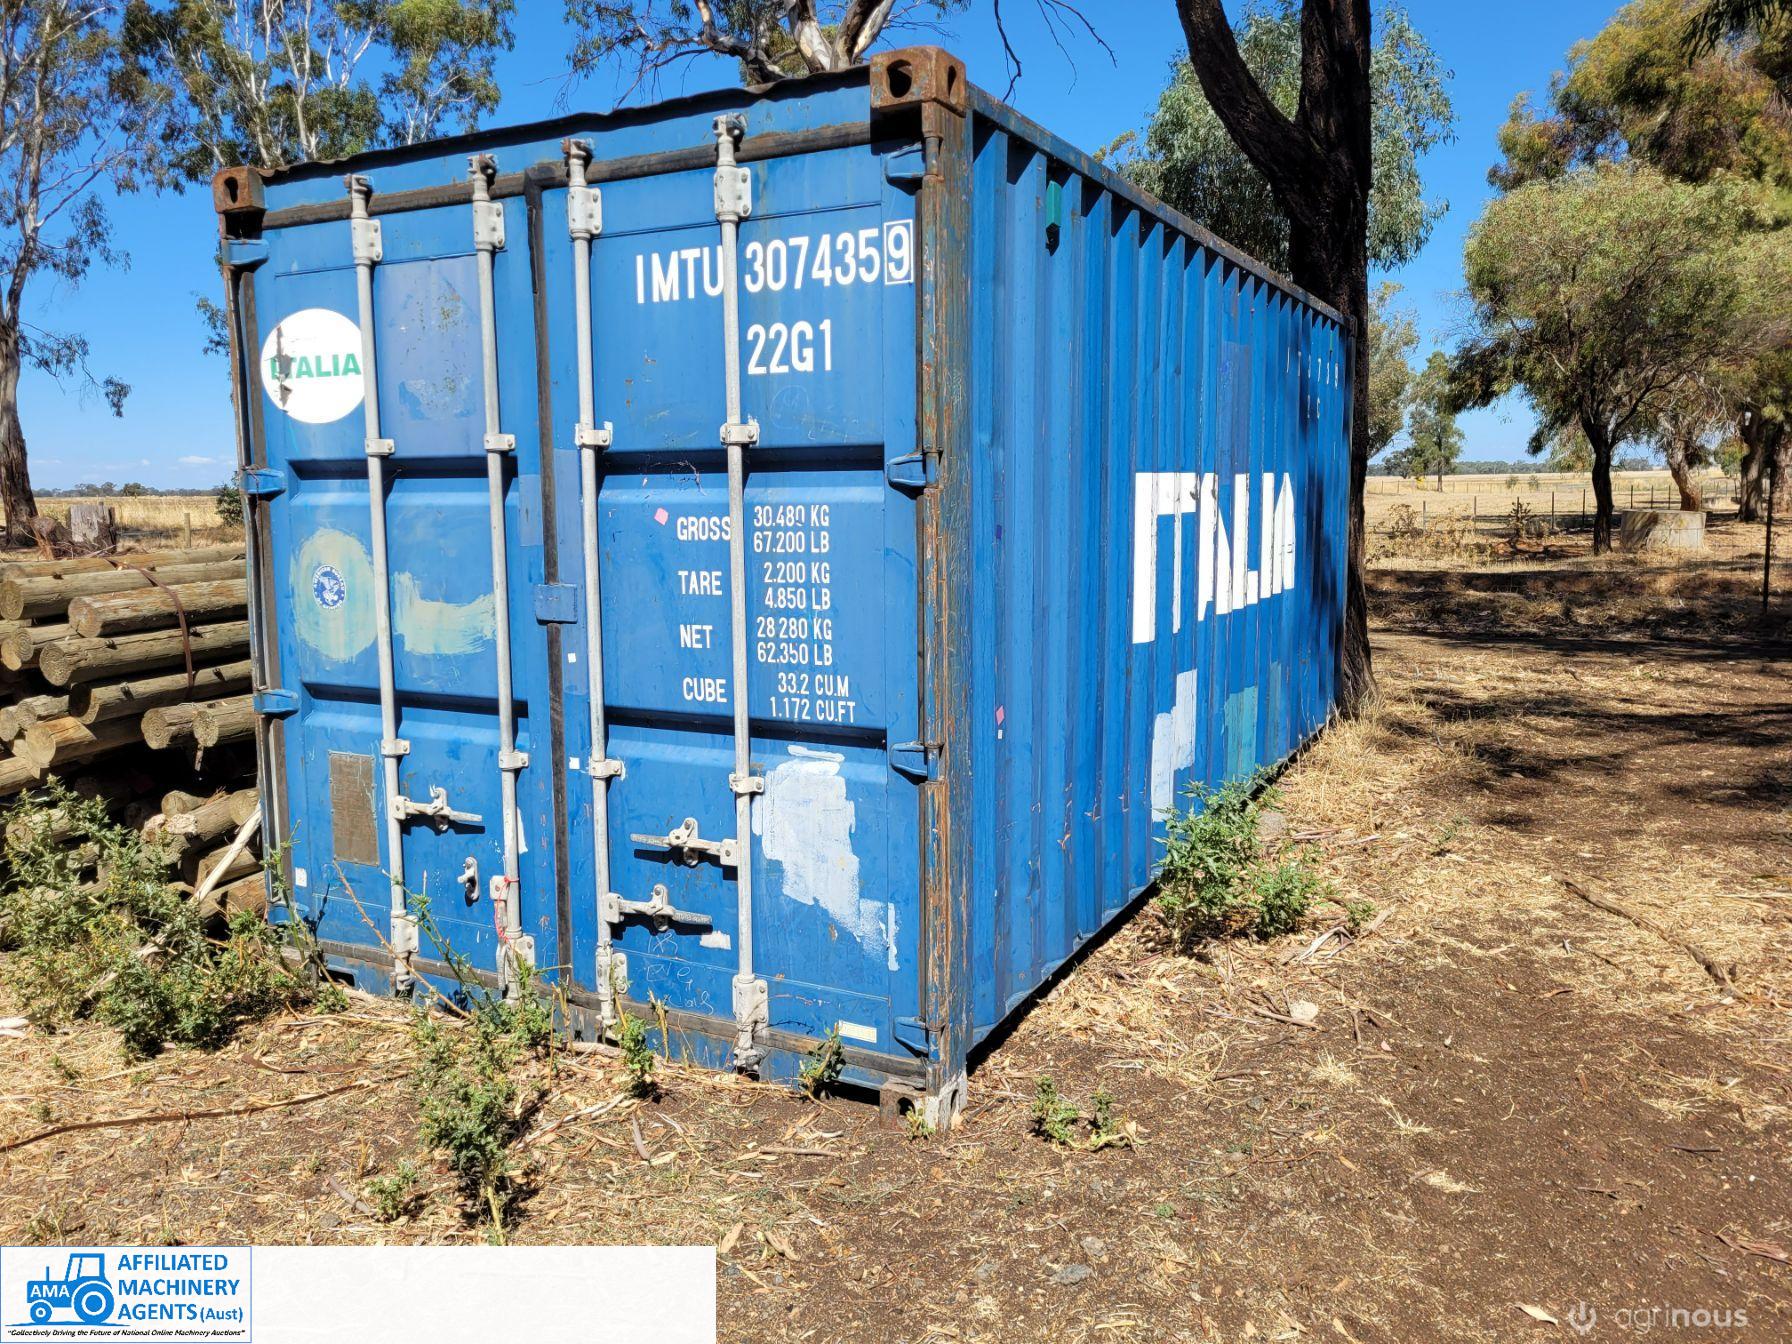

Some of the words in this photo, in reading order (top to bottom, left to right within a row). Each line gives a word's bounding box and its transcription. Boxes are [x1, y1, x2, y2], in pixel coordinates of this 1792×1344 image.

[636, 245, 724, 304] IMTU
[747, 319, 832, 375] 22G1
[753, 505, 805, 527] 30.480
[810, 505, 829, 527] KG
[677, 516, 731, 541] GROSS
[753, 531, 805, 553] 67.200
[810, 531, 829, 553] LB
[678, 571, 722, 595] TARE
[764, 562, 806, 583] 2.200
[811, 562, 830, 584] KG
[764, 587, 806, 609] 4.850
[812, 588, 831, 609] LB
[680, 624, 713, 648] NET
[813, 618, 832, 640] KG
[757, 642, 808, 664] 62.350
[814, 644, 832, 666] LB
[683, 677, 727, 702] CUBE
[778, 672, 809, 695] 33.2
[770, 697, 811, 720] 1.172
